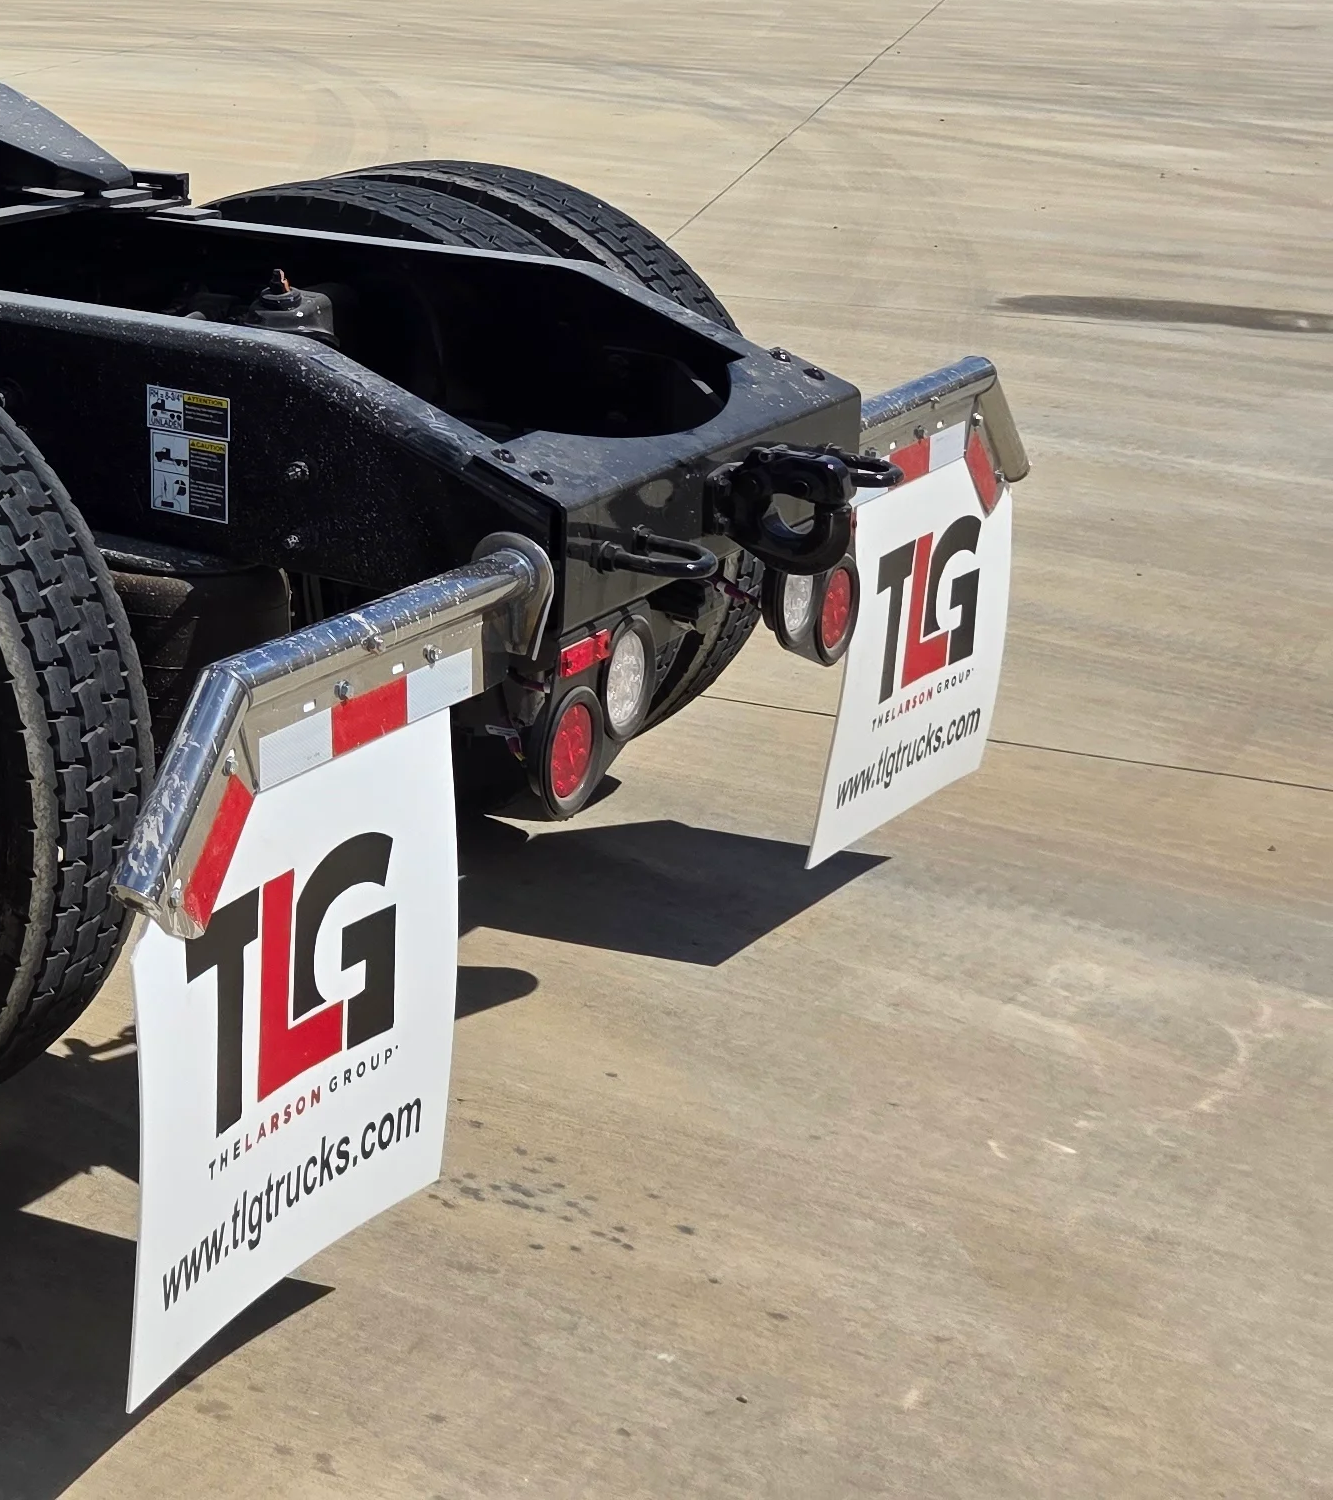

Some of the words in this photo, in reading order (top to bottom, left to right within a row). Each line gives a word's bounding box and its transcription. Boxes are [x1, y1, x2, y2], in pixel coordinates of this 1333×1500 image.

[150, 415, 182, 430] UNLADEN
[187, 395, 224, 407] ATTENTION
[195, 440, 226, 453] CAUTION
[877, 515, 981, 704] TLG
[936, 668, 971, 695] GROUP
[836, 706, 981, 810] www.tlgtrucks.com
[185, 831, 397, 1139] TLG
[328, 1047, 394, 1093] GROUP
[161, 1096, 422, 1313] www.tlgtrucks.com
